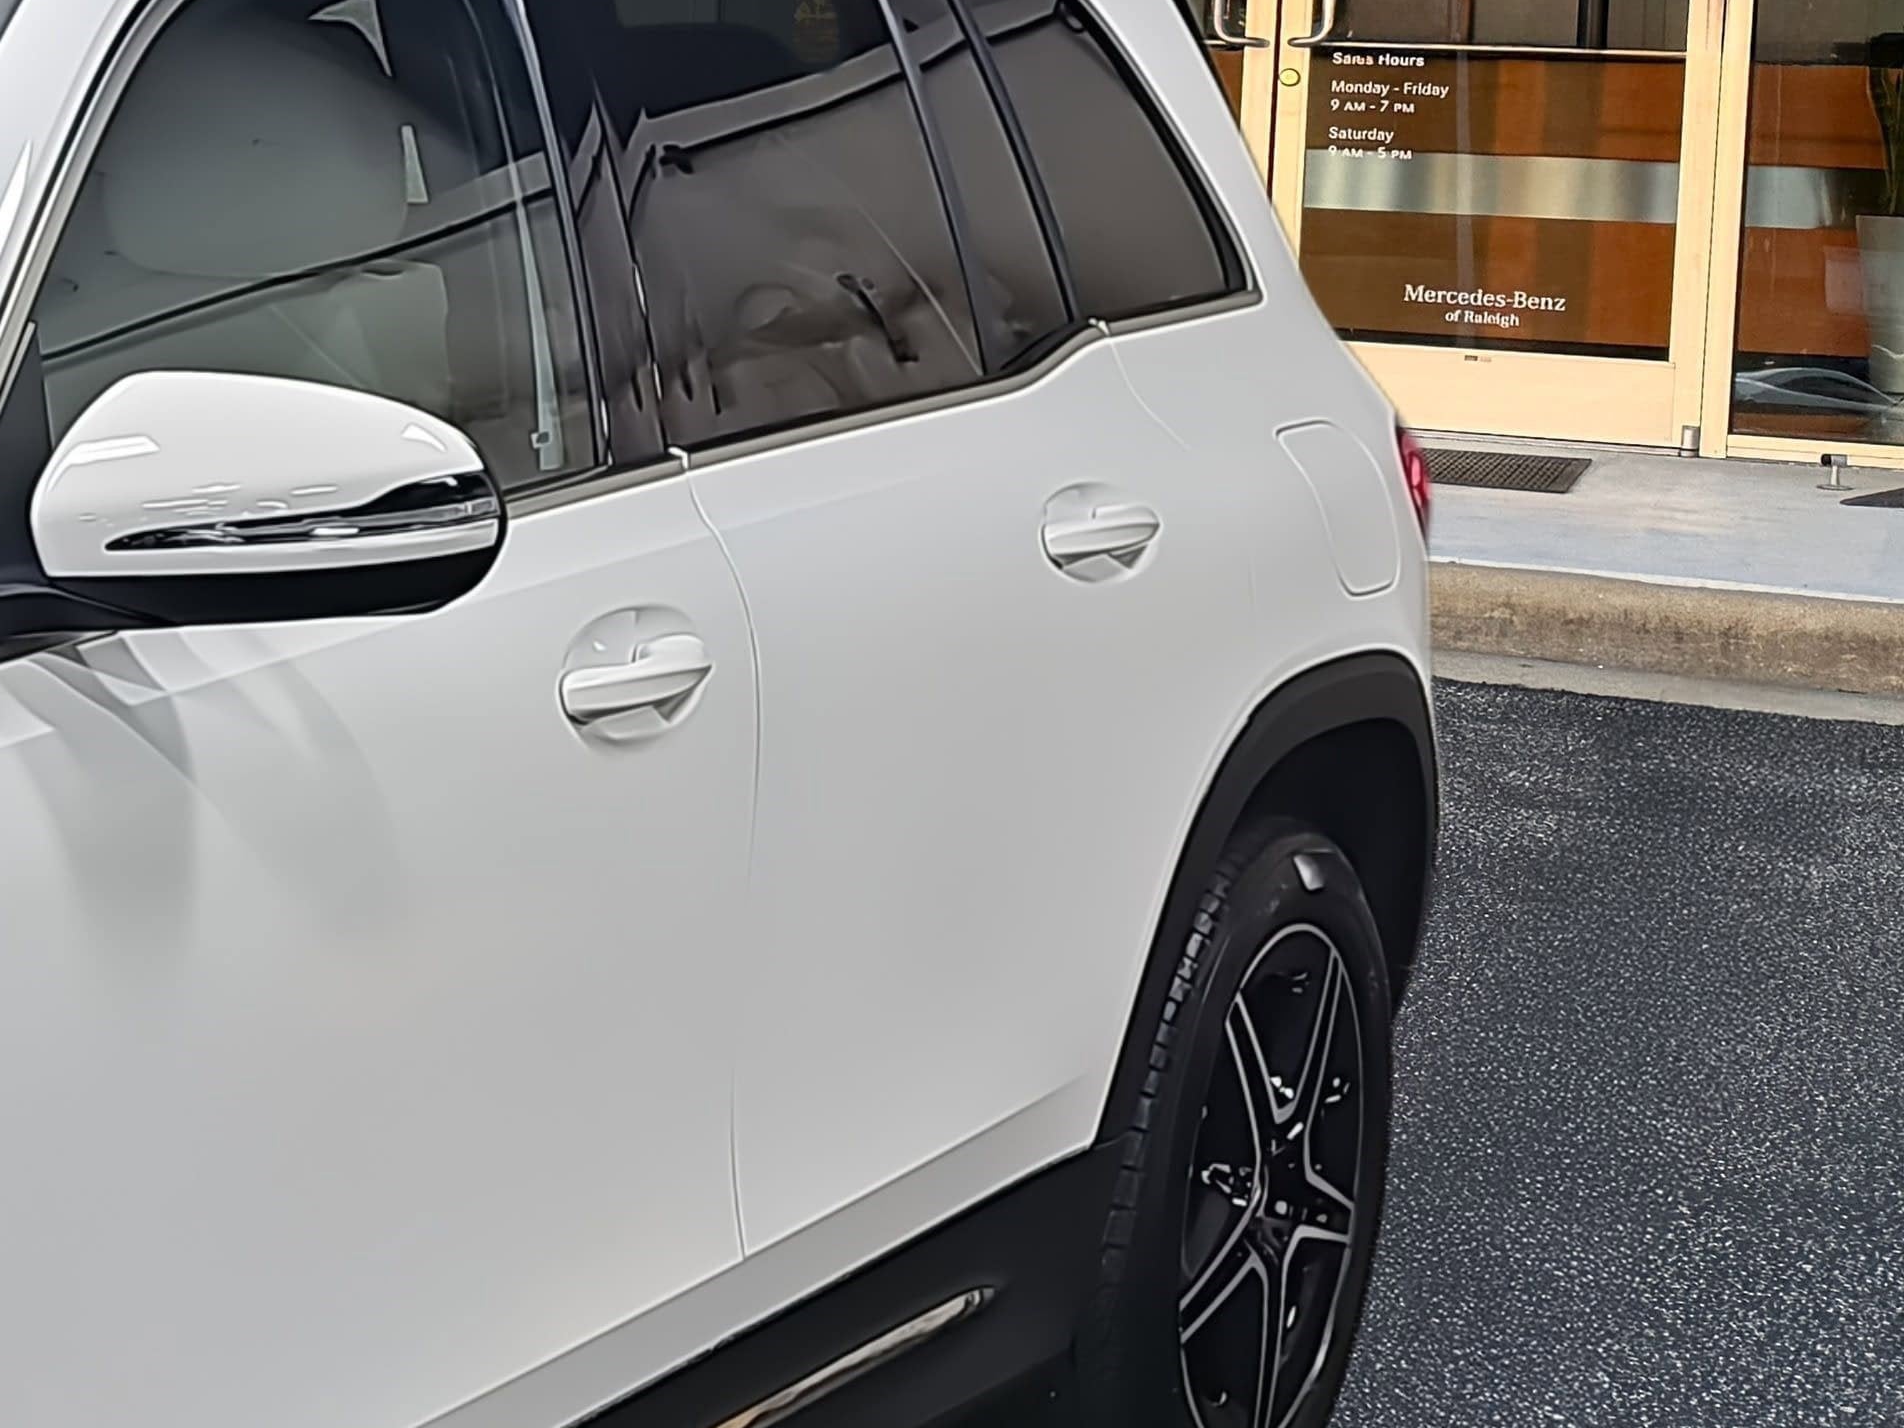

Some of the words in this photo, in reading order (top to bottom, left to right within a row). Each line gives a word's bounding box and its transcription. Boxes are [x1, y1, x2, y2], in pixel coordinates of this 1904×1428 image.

[1378, 52, 1425, 67] Hours
[1331, 80, 1390, 97] Monday
[1403, 82, 1449, 99] Friday
[1330, 99, 1340, 112] 9
[1344, 102, 1366, 112] AM
[1379, 100, 1390, 113] 7
[1393, 103, 1415, 113] PM
[1328, 126, 1394, 144] Saturday
[1391, 149, 1413, 160] PM
[1403, 284, 1566, 312] Mercedes-Benz
[1445, 309, 1462, 322] of
